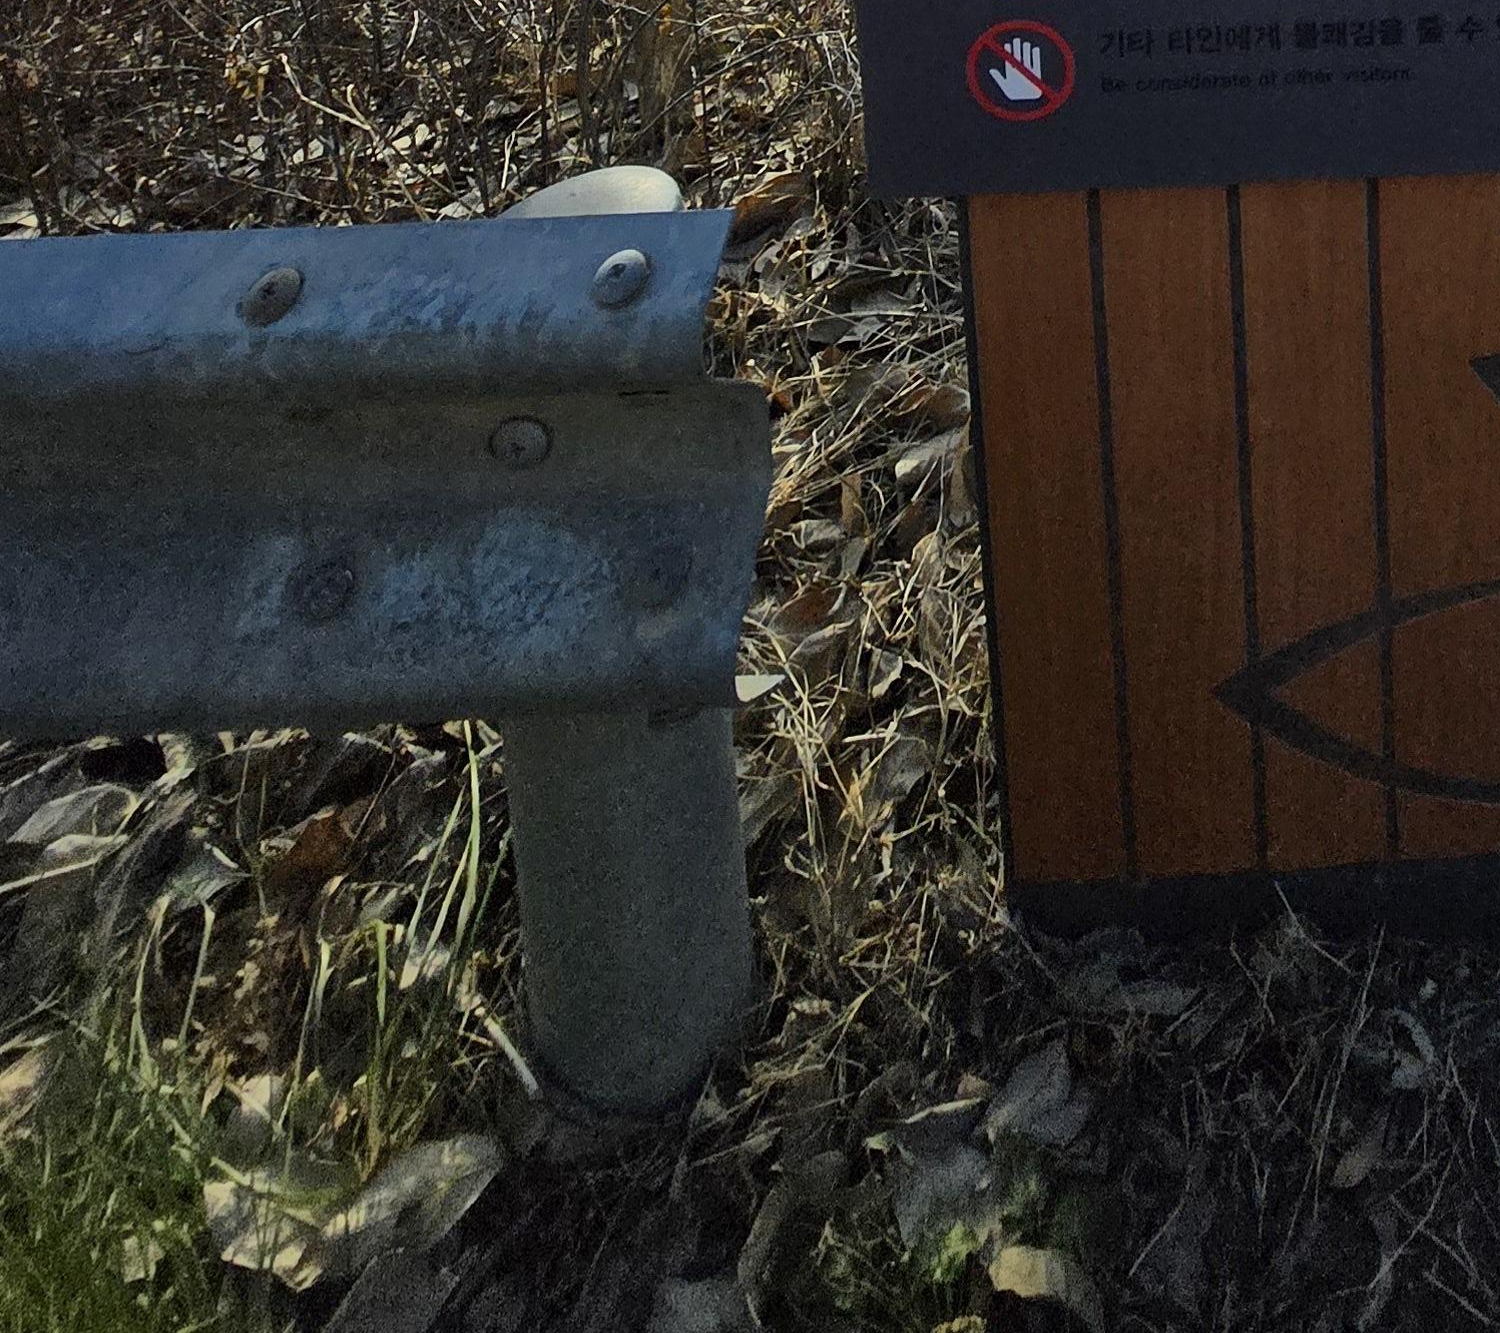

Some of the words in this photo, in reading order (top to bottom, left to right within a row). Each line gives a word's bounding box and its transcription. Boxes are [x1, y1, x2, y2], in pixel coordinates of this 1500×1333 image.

[1099, 29, 1154, 57] 기타
[1167, 23, 1282, 55] 타인에게
[1455, 16, 1484, 42] 수
